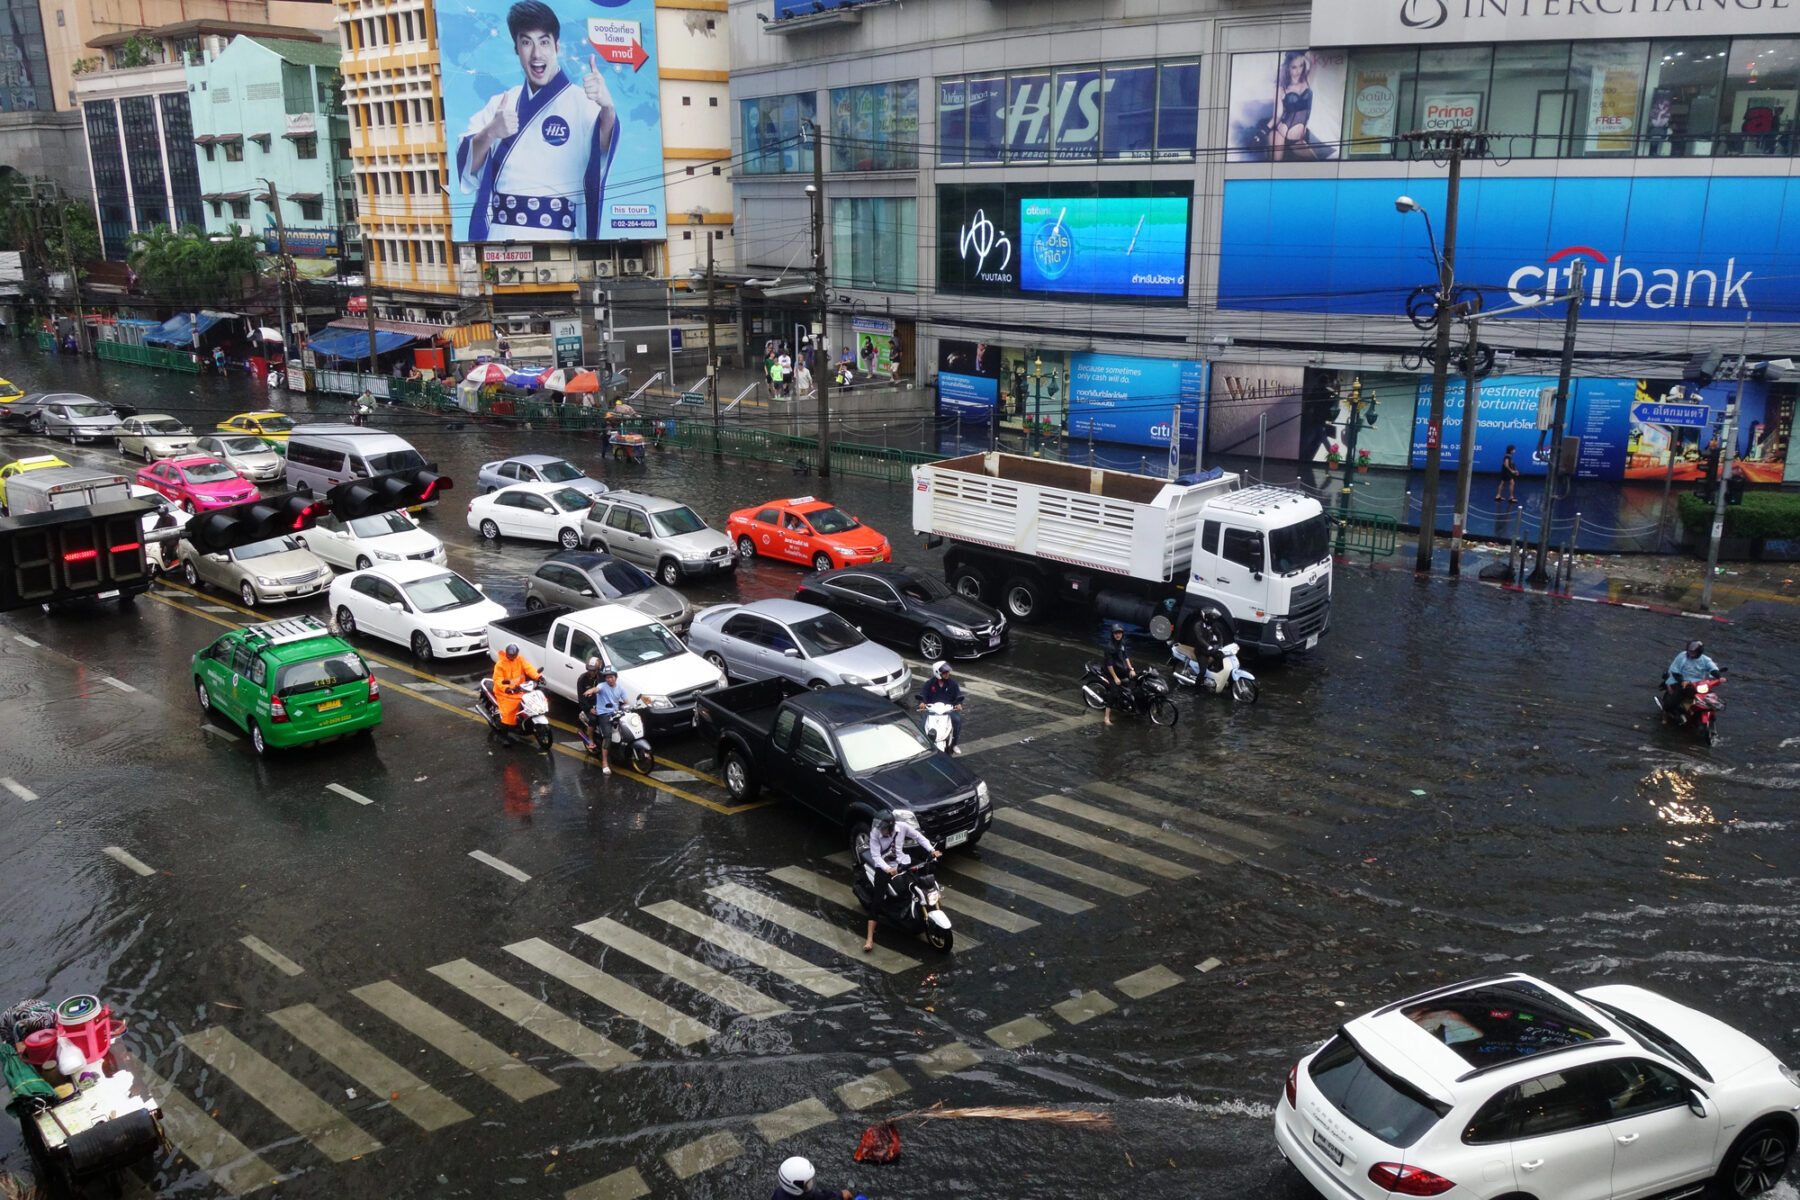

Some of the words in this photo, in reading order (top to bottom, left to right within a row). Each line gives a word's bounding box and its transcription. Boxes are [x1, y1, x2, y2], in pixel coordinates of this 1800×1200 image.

[604, 33, 625, 43] ได้เลย
[611, 47, 633, 59] ทางนี้
[1426, 105, 1474, 118] Prima
[1426, 117, 1473, 129] dental
[1595, 116, 1622, 124] FREE
[614, 206, 626, 214] his
[628, 206, 648, 214] tours
[981, 273, 1012, 283] YUUTARO
[1507, 255, 1753, 308] citibank
[1077, 363, 1104, 372] Because
[1105, 365, 1142, 376] sometimes
[1092, 373, 1107, 382] cash
[1224, 376, 1267, 400] Wall
[1151, 425, 1170, 437] citi
[314, 676, 337, 687] 4493
